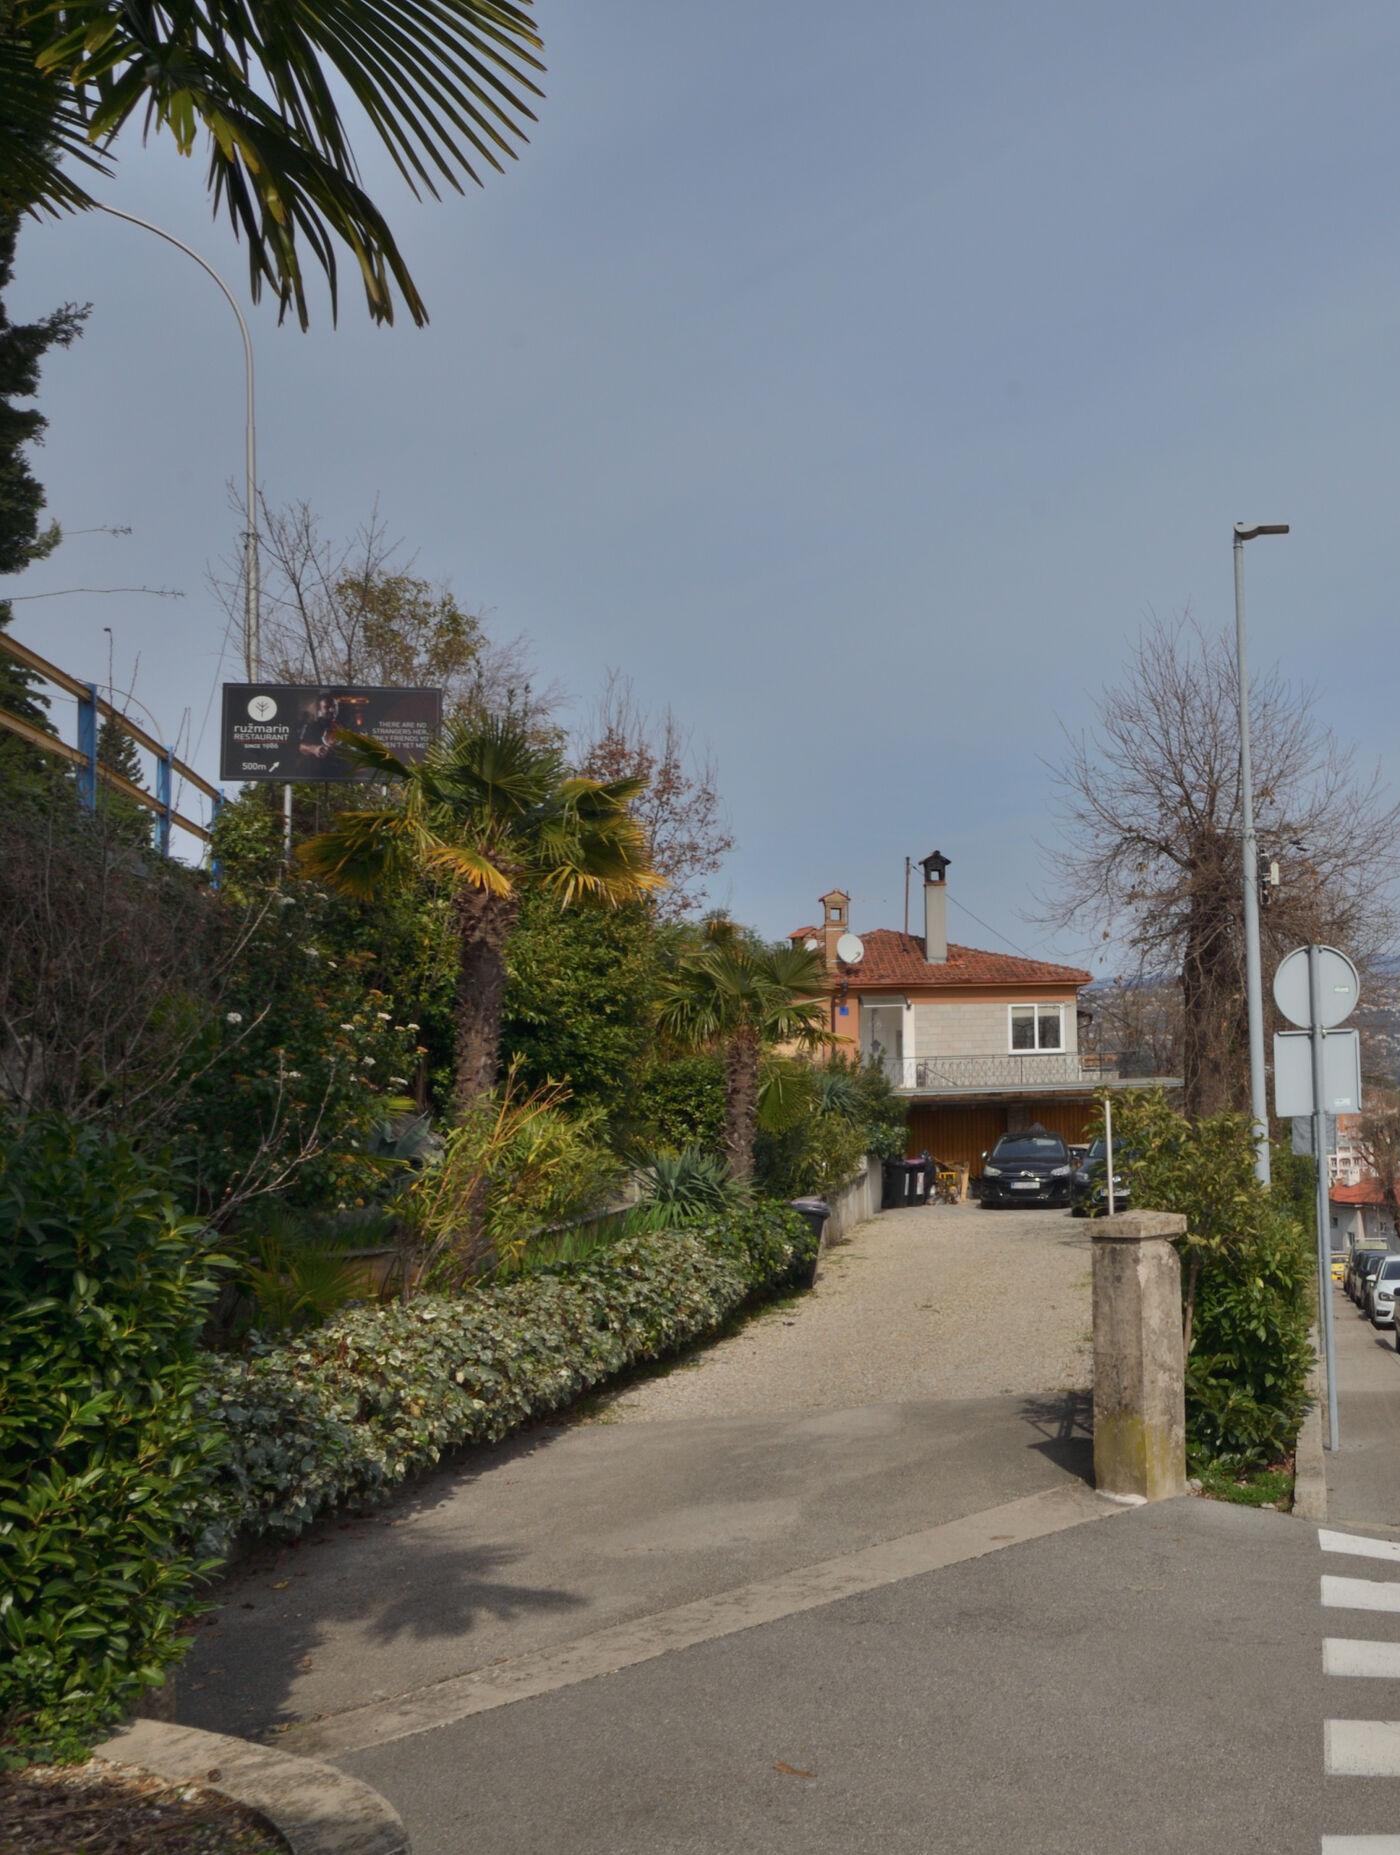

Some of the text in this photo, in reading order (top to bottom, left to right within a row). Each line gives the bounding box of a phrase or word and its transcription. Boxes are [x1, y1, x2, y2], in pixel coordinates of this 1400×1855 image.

[233, 723, 290, 733] ružmarin
[233, 733, 289, 741] RESTAURANT
[242, 762, 267, 770] 500m
